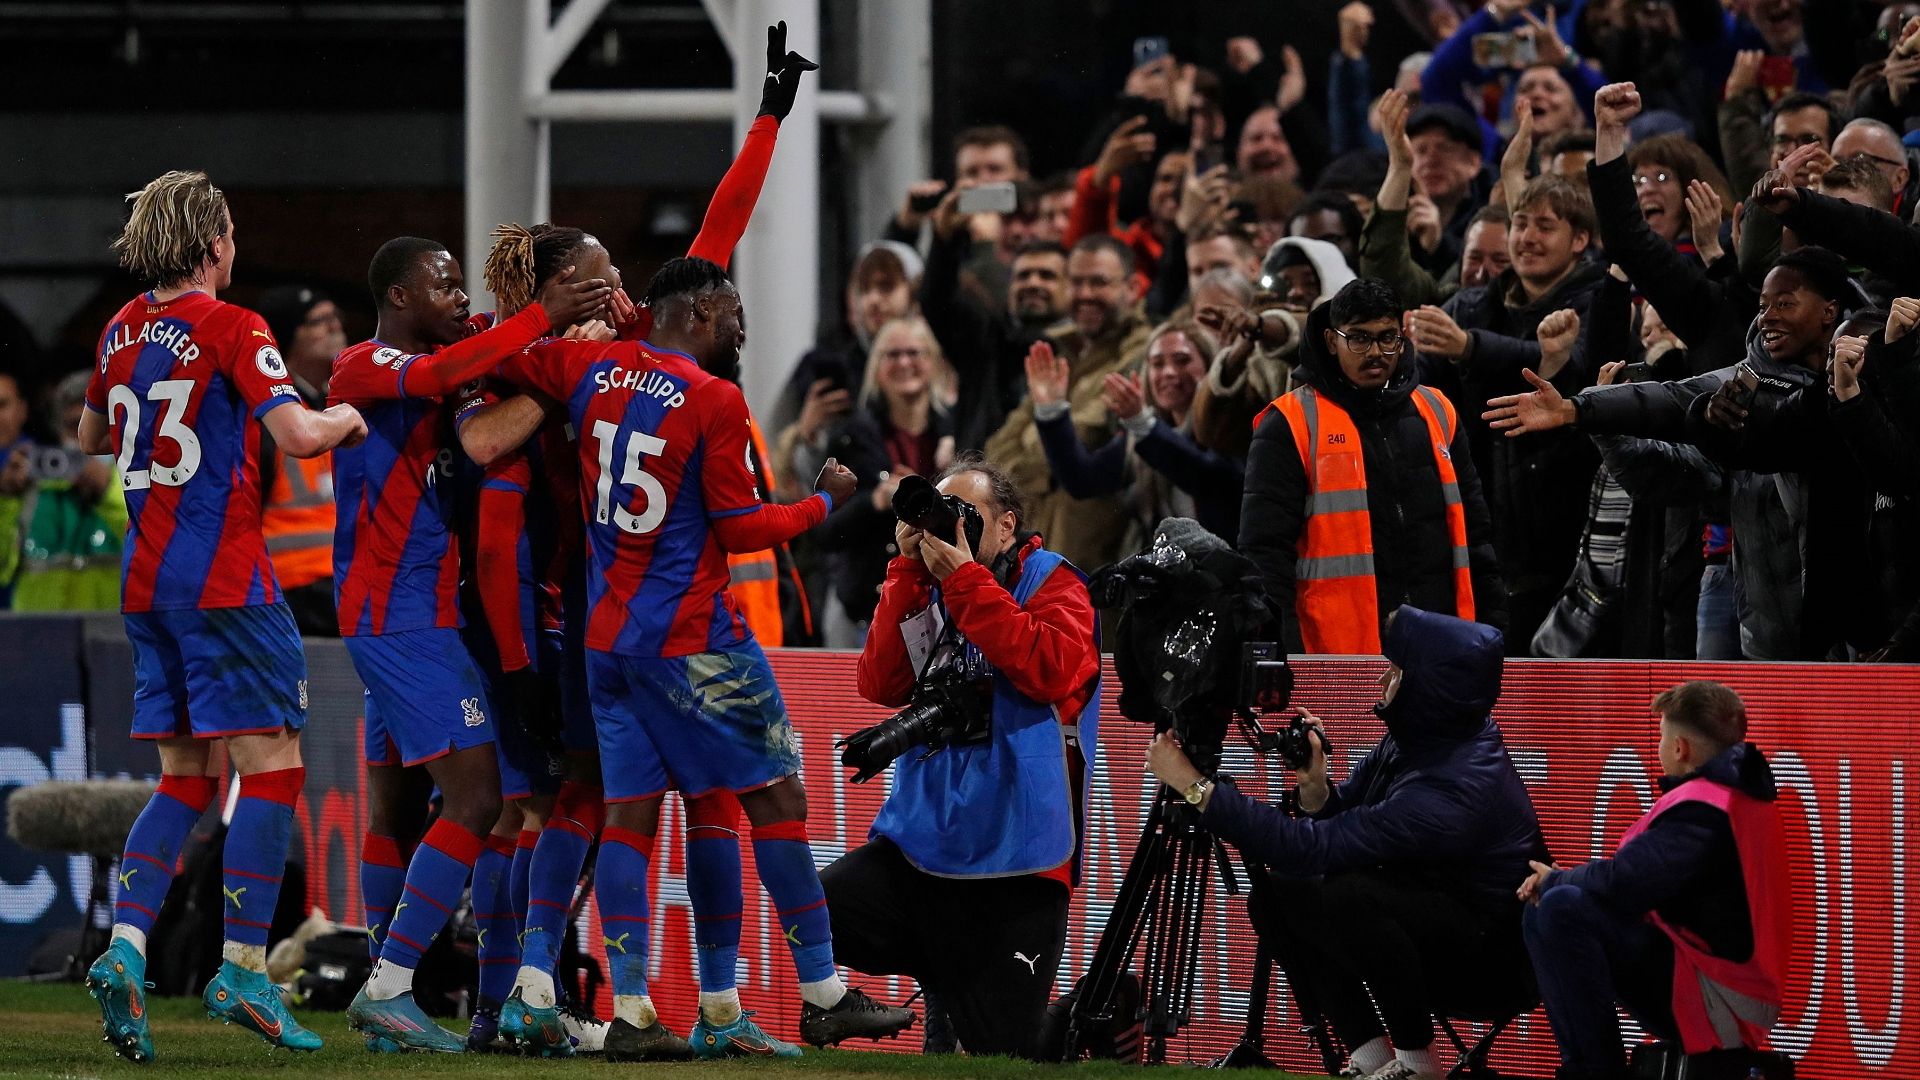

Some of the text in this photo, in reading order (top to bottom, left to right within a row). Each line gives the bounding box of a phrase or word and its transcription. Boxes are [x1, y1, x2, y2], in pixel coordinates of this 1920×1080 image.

[101, 320, 200, 374] GALLAGHER
[593, 366, 686, 410] SCHLUPP
[108, 380, 201, 490] 23
[1328, 433, 1346, 444] 240
[592, 419, 667, 534] 15
